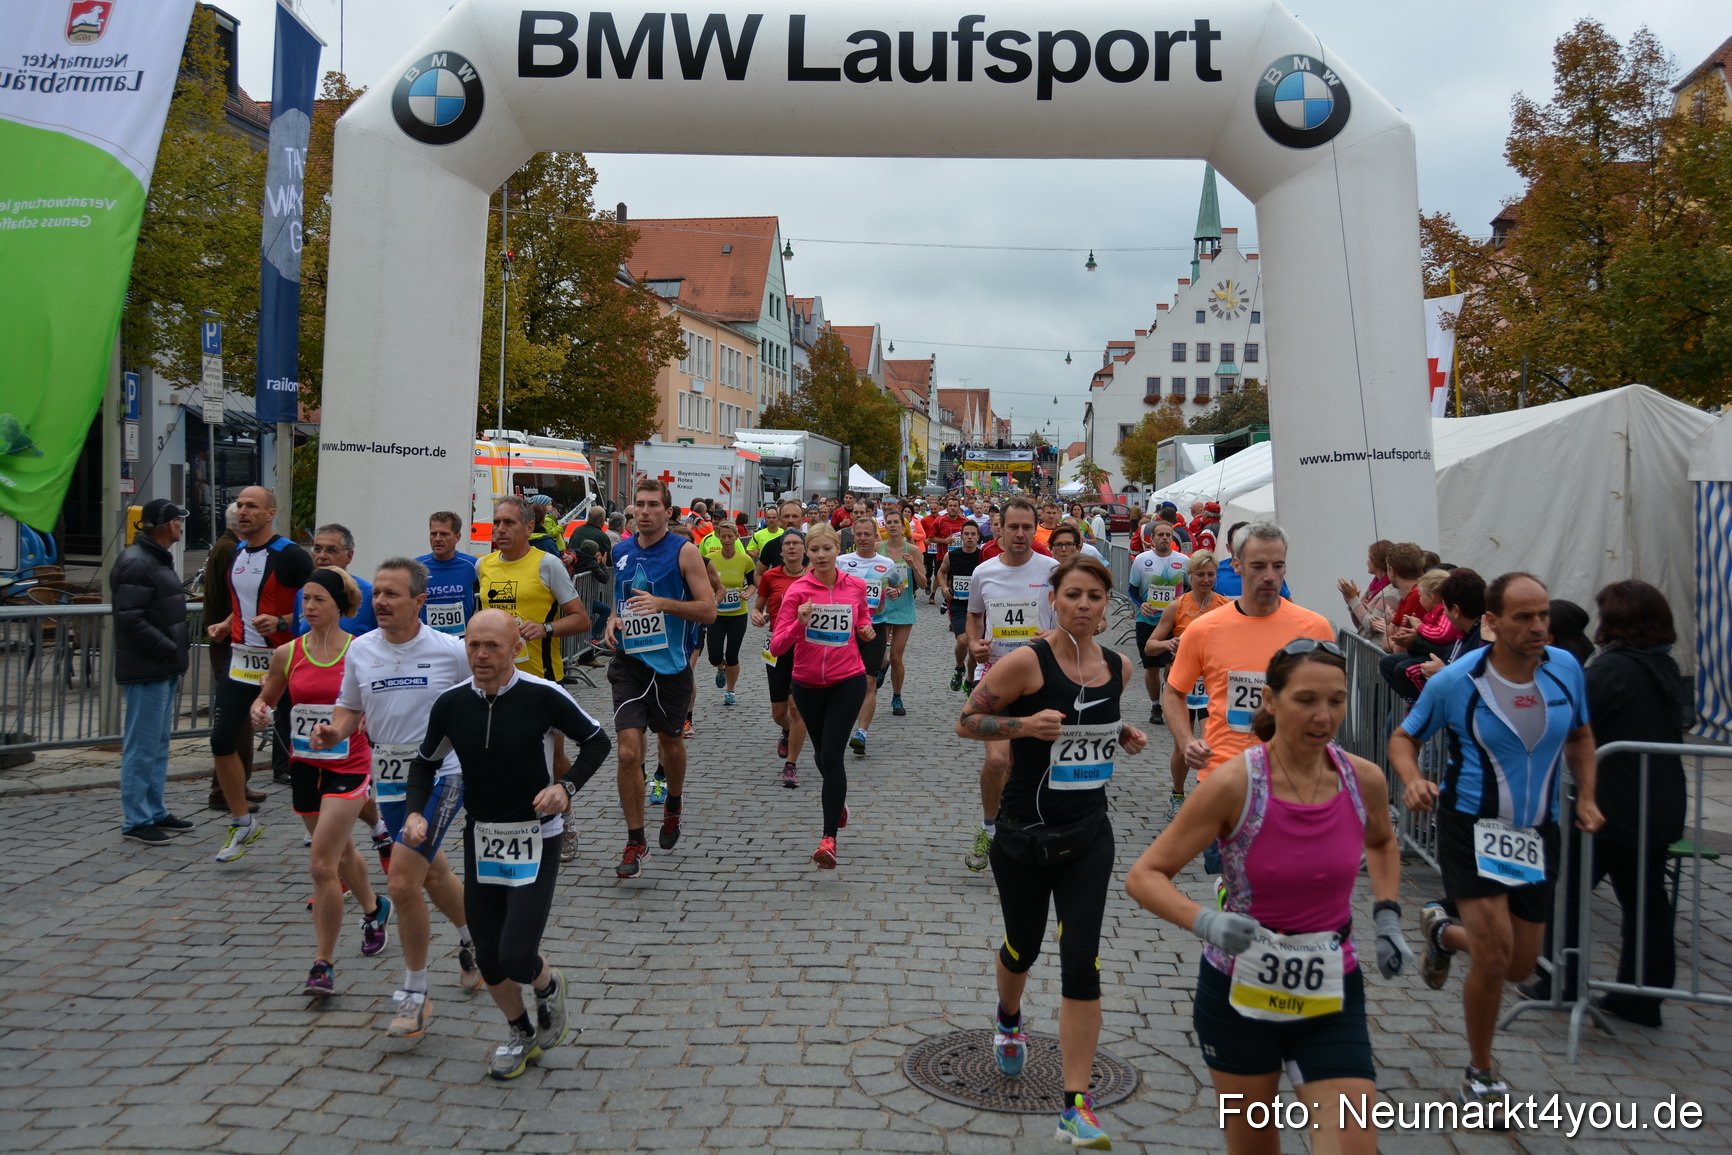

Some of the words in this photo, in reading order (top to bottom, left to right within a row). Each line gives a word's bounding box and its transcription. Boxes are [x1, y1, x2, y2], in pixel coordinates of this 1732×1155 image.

[518, 10, 764, 81] BMW
[787, 14, 1222, 101] Laufsport
[403, 53, 478, 84] BMW
[1263, 55, 1341, 88] BMW
[206, 320, 217, 349] P
[128, 379, 136, 414] P
[157, 436, 165, 451] 3
[321, 440, 447, 458] www.bmw-laufsport.de
[1299, 447, 1431, 466] www.bmw-laufsport.de
[677, 470, 711, 478] Bayerisches
[616, 554, 629, 571] 4
[954, 581, 972, 591] 252
[1152, 590, 1171, 602] 518
[430, 611, 462, 626] 2590
[810, 613, 849, 631] 2215
[1004, 608, 1025, 626] 44
[624, 616, 662, 637] 2092
[1001, 629, 1029, 637] Matthias
[633, 638, 653, 646] Martin
[817, 633, 840, 642] Natalie
[242, 654, 270, 671] 103
[1229, 675, 1253, 684] PARTL
[1234, 685, 1262, 709] 25
[1058, 738, 1117, 762] 2316
[1073, 767, 1100, 780] Nicola
[475, 825, 493, 835] PARTL
[494, 828, 529, 836] Neumarkt
[482, 835, 533, 860] 2241
[1483, 832, 1539, 865] 2626
[1496, 862, 1525, 879] Oliver
[1279, 941, 1327, 952] Neumarkt
[1257, 952, 1325, 991] 386
[1268, 994, 1305, 1014] Kelly
